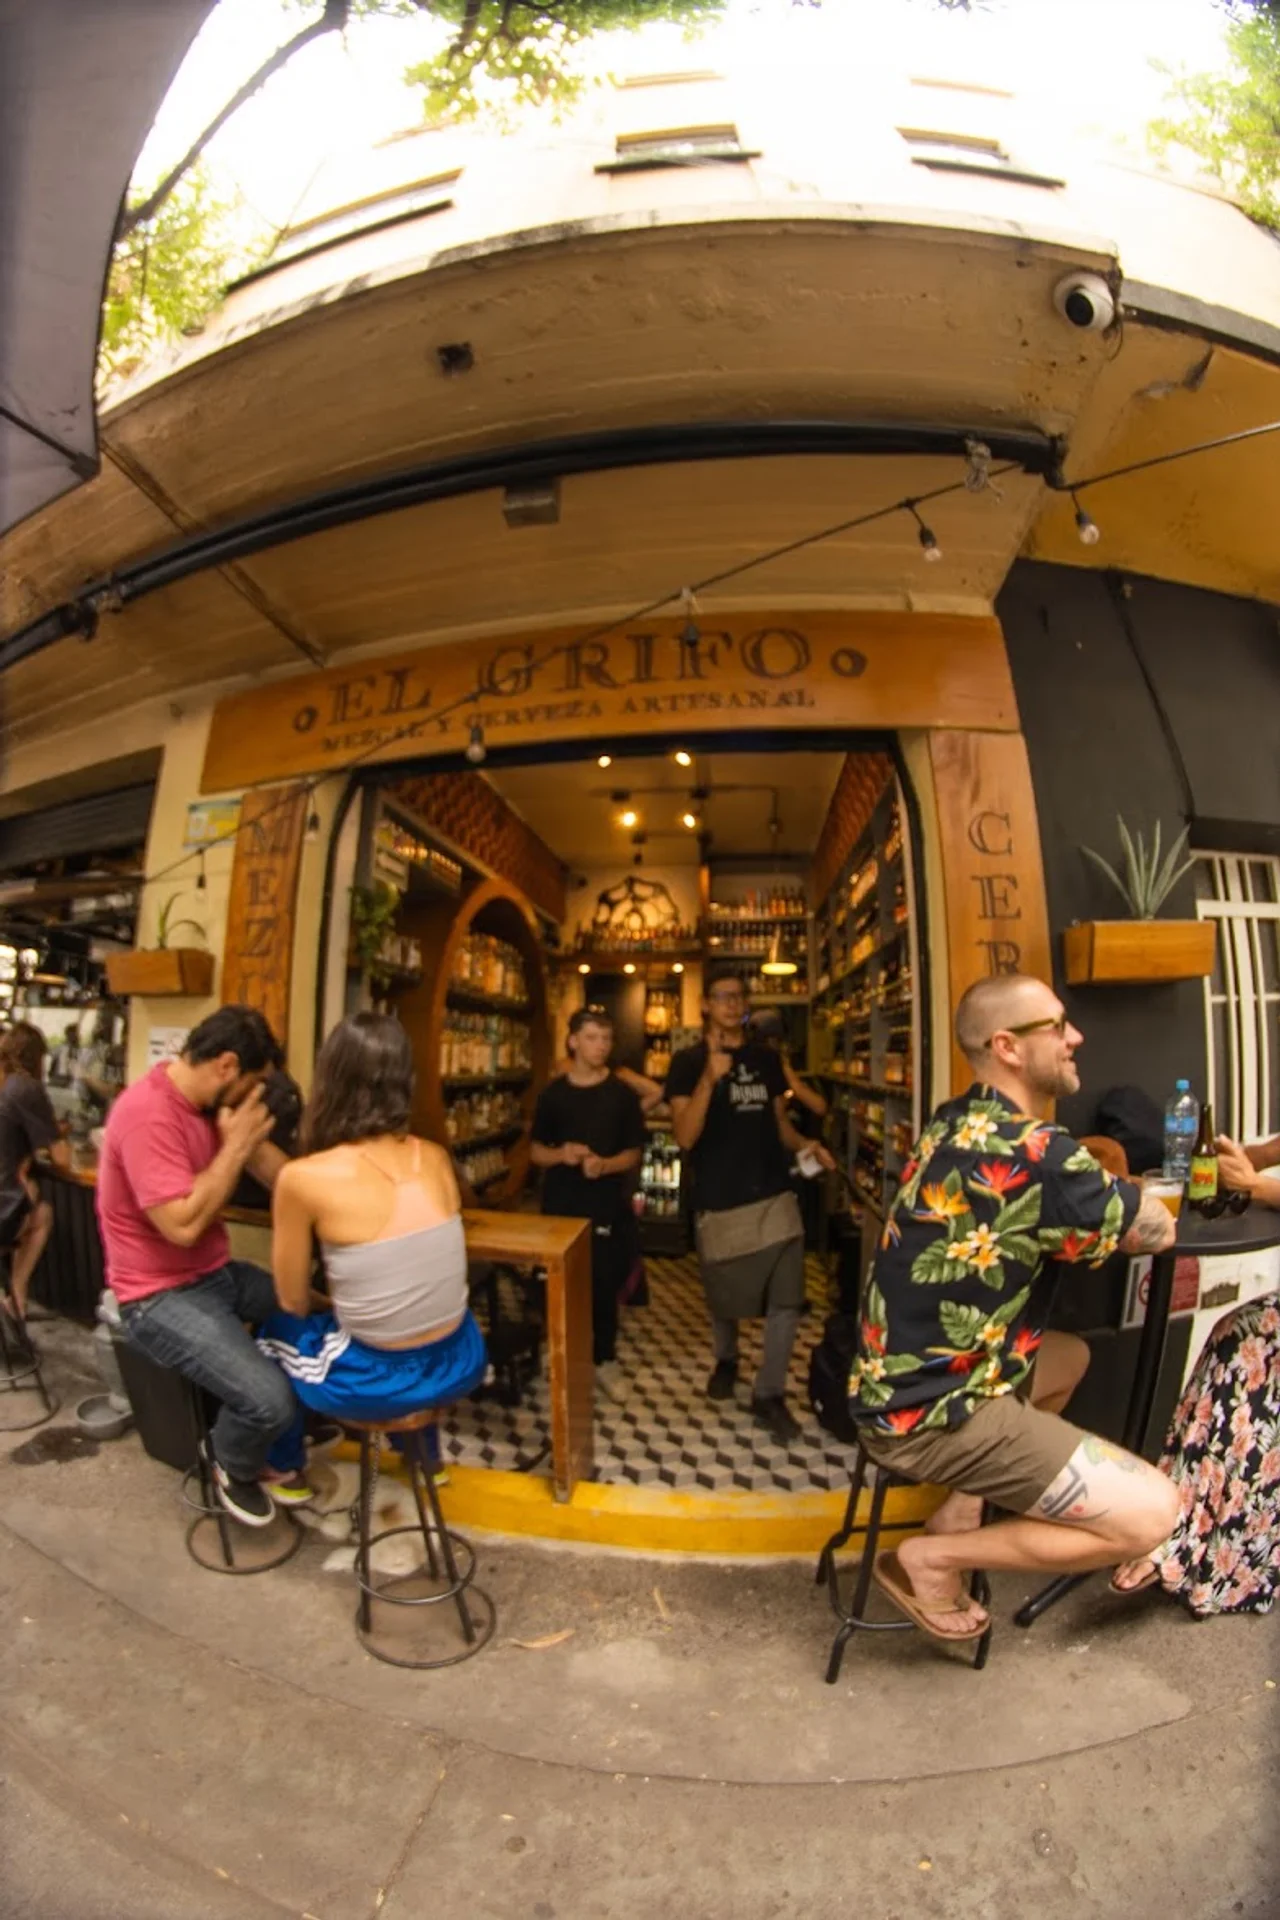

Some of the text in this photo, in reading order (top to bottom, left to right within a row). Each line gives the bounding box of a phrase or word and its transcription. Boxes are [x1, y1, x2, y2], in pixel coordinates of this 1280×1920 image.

[329, 628, 812, 724] EL GRIFO
[437, 716, 452, 734] Y
[467, 701, 602, 729] CERVEZA
[621, 688, 816, 716] ARTESANAL
